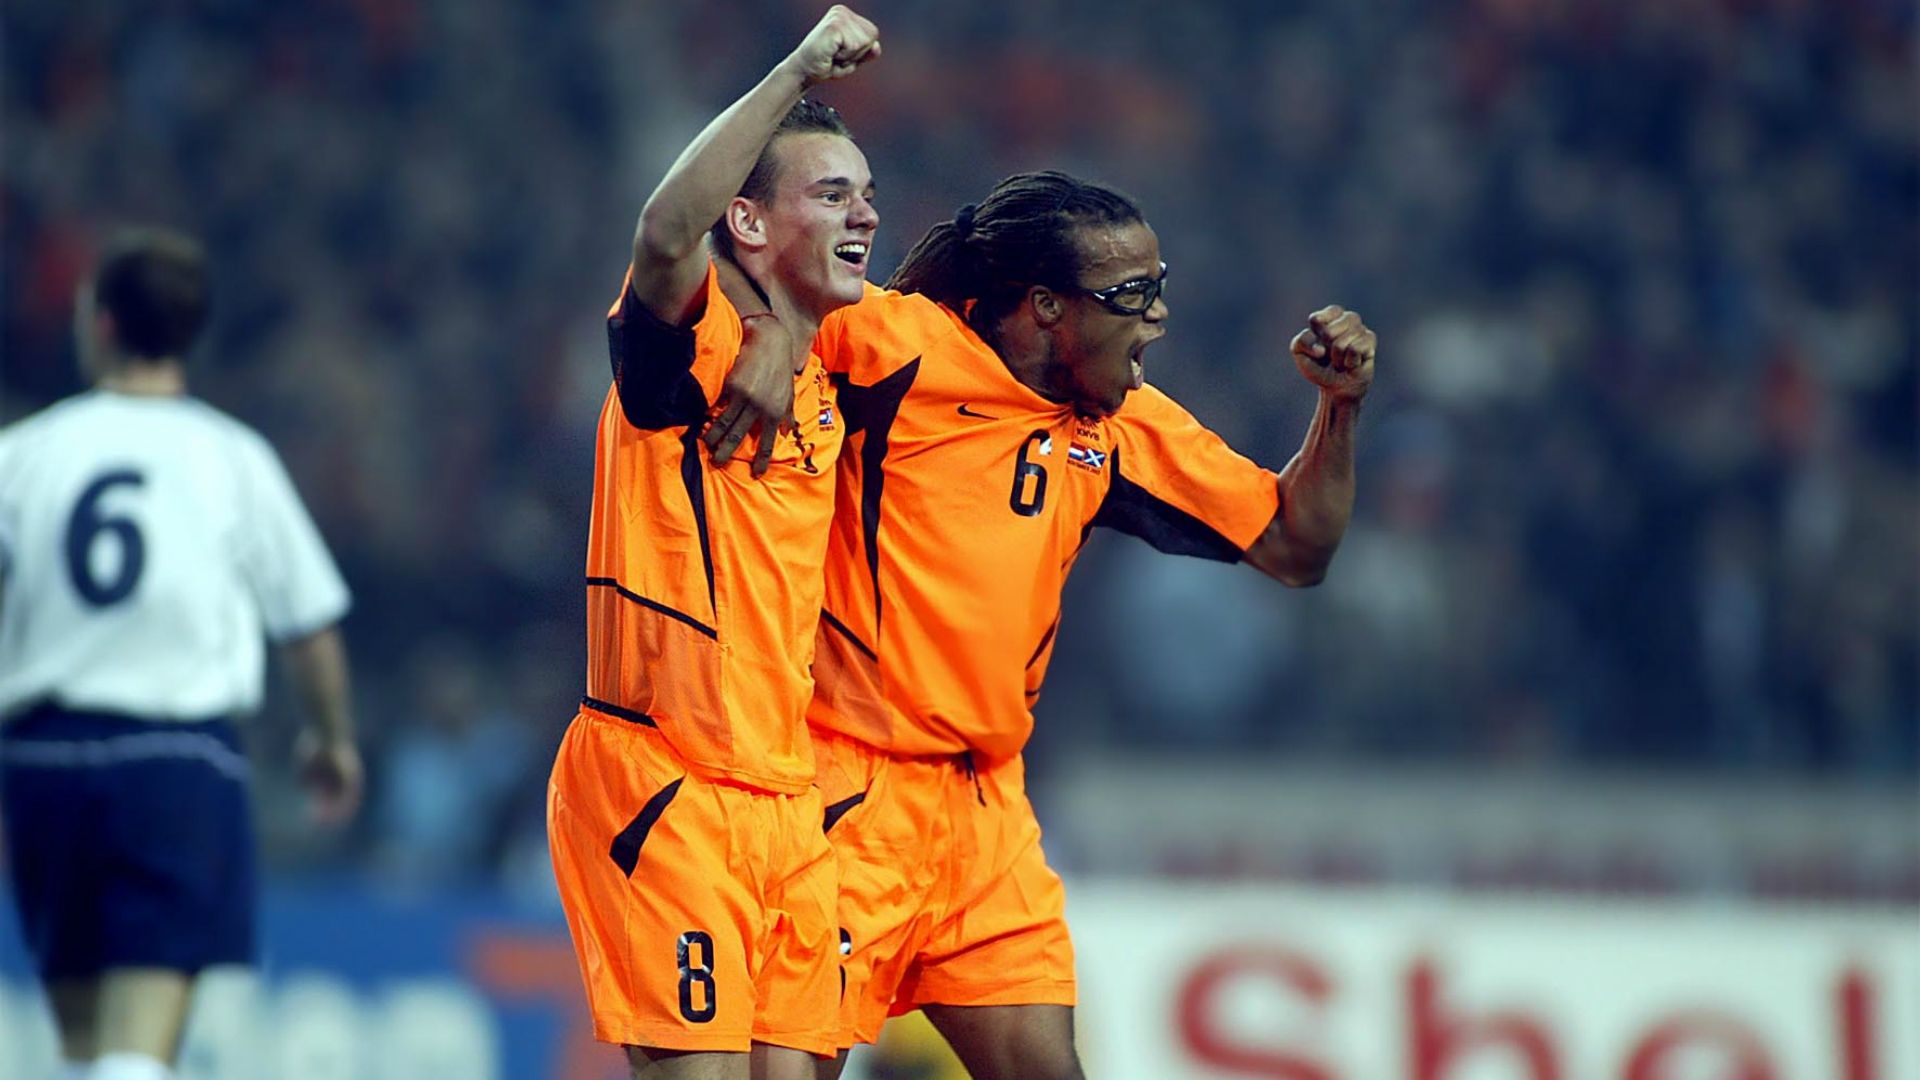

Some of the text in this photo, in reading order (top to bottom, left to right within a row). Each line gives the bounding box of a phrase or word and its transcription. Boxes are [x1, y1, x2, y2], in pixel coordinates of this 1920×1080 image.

[1010, 428, 1051, 517] 6
[64, 468, 146, 610] 6
[677, 931, 717, 1024] 8
